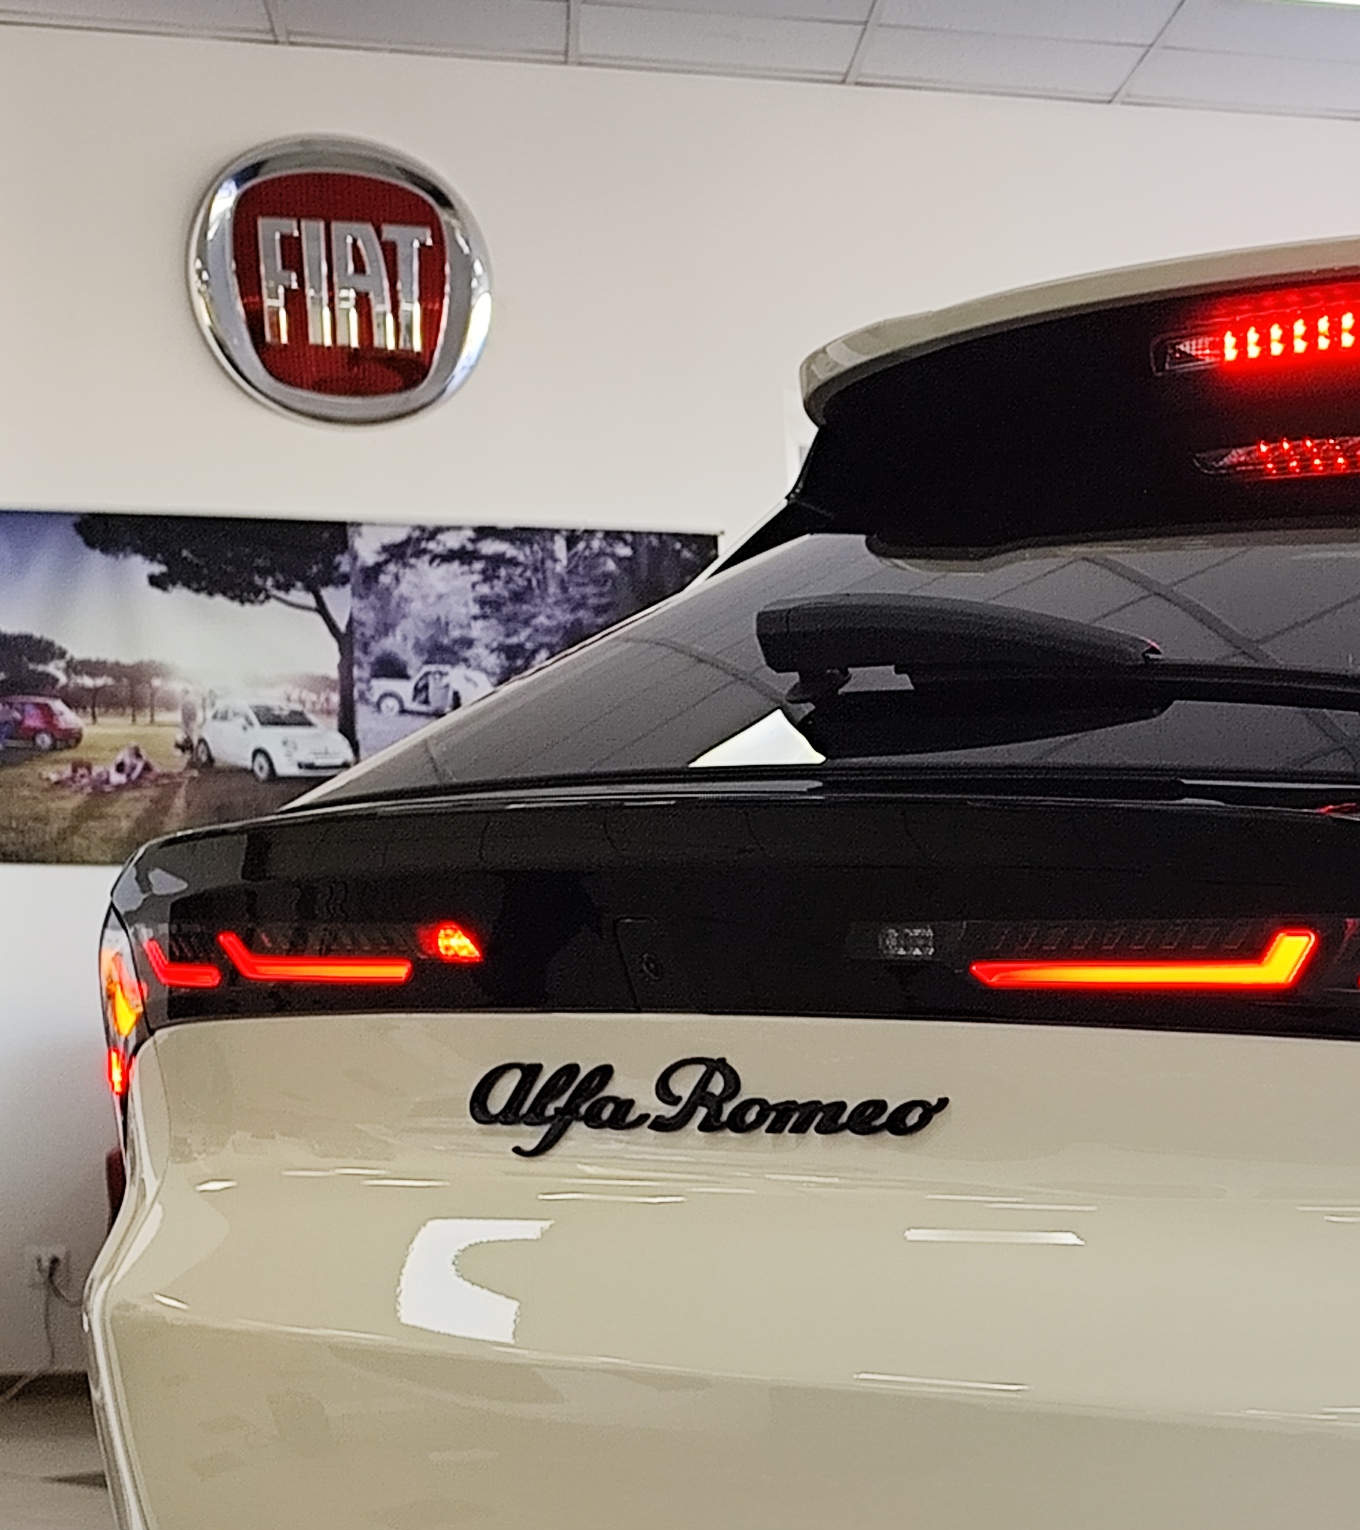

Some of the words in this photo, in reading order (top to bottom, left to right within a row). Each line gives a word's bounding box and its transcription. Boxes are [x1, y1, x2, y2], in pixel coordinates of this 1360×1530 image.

[257, 216, 433, 352] FIAT
[468, 1061, 651, 1158] Alfa
[646, 1056, 950, 1137] Romeo
